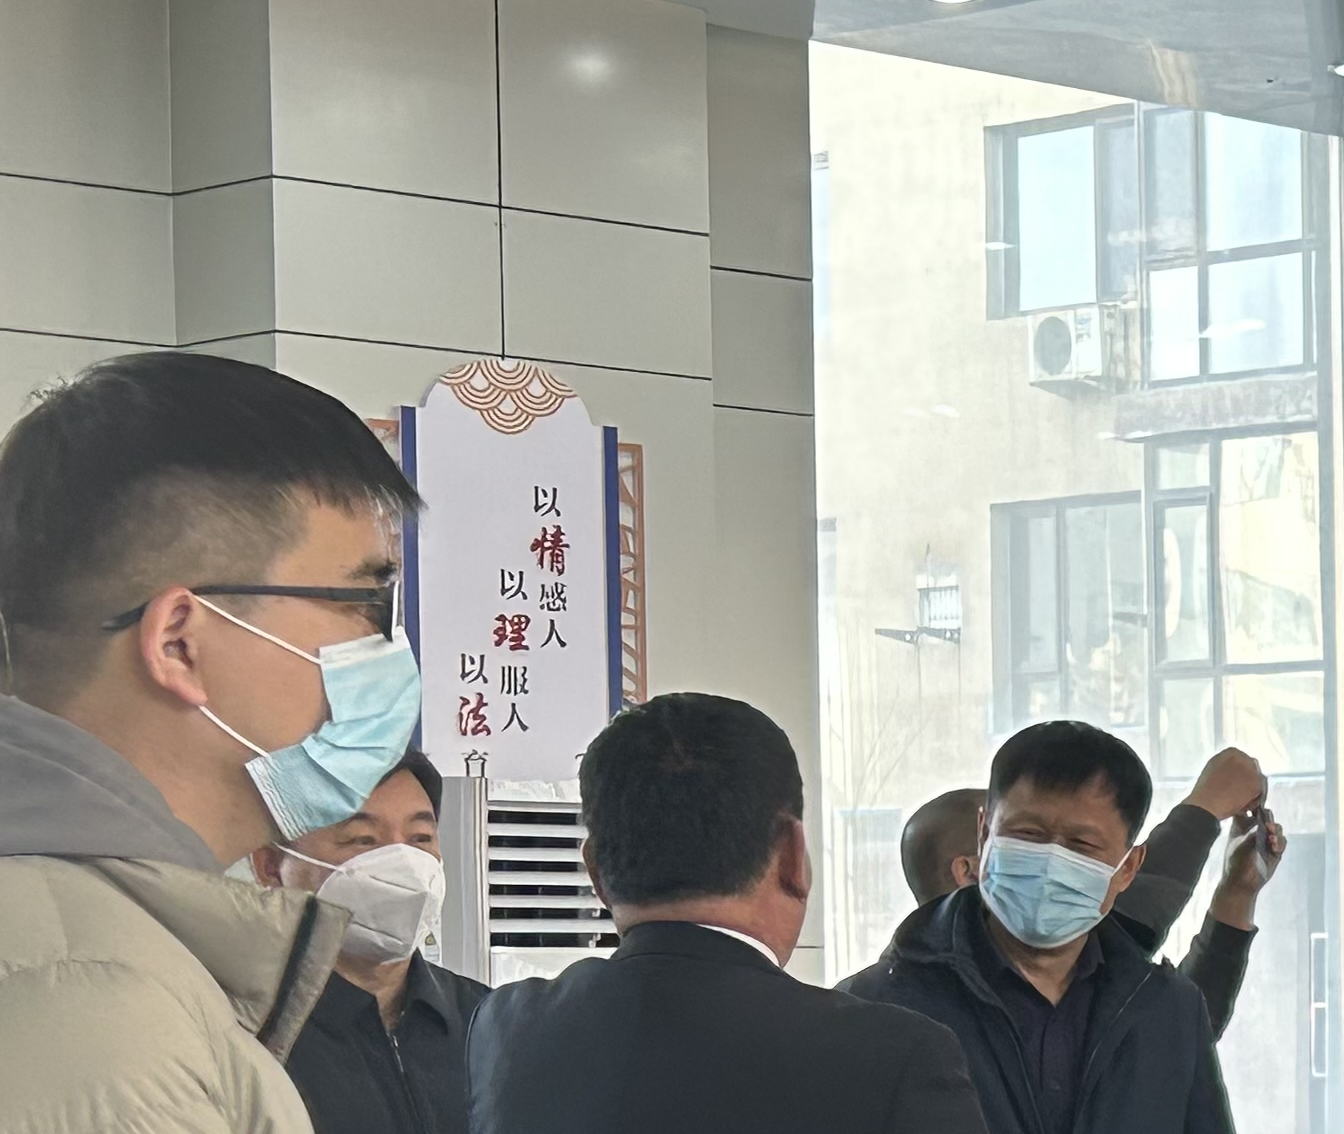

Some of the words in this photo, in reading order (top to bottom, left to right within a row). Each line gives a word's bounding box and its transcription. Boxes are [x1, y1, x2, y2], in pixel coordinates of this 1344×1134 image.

[529, 485, 571, 649] 以情感人
[492, 569, 532, 733] 以理服人
